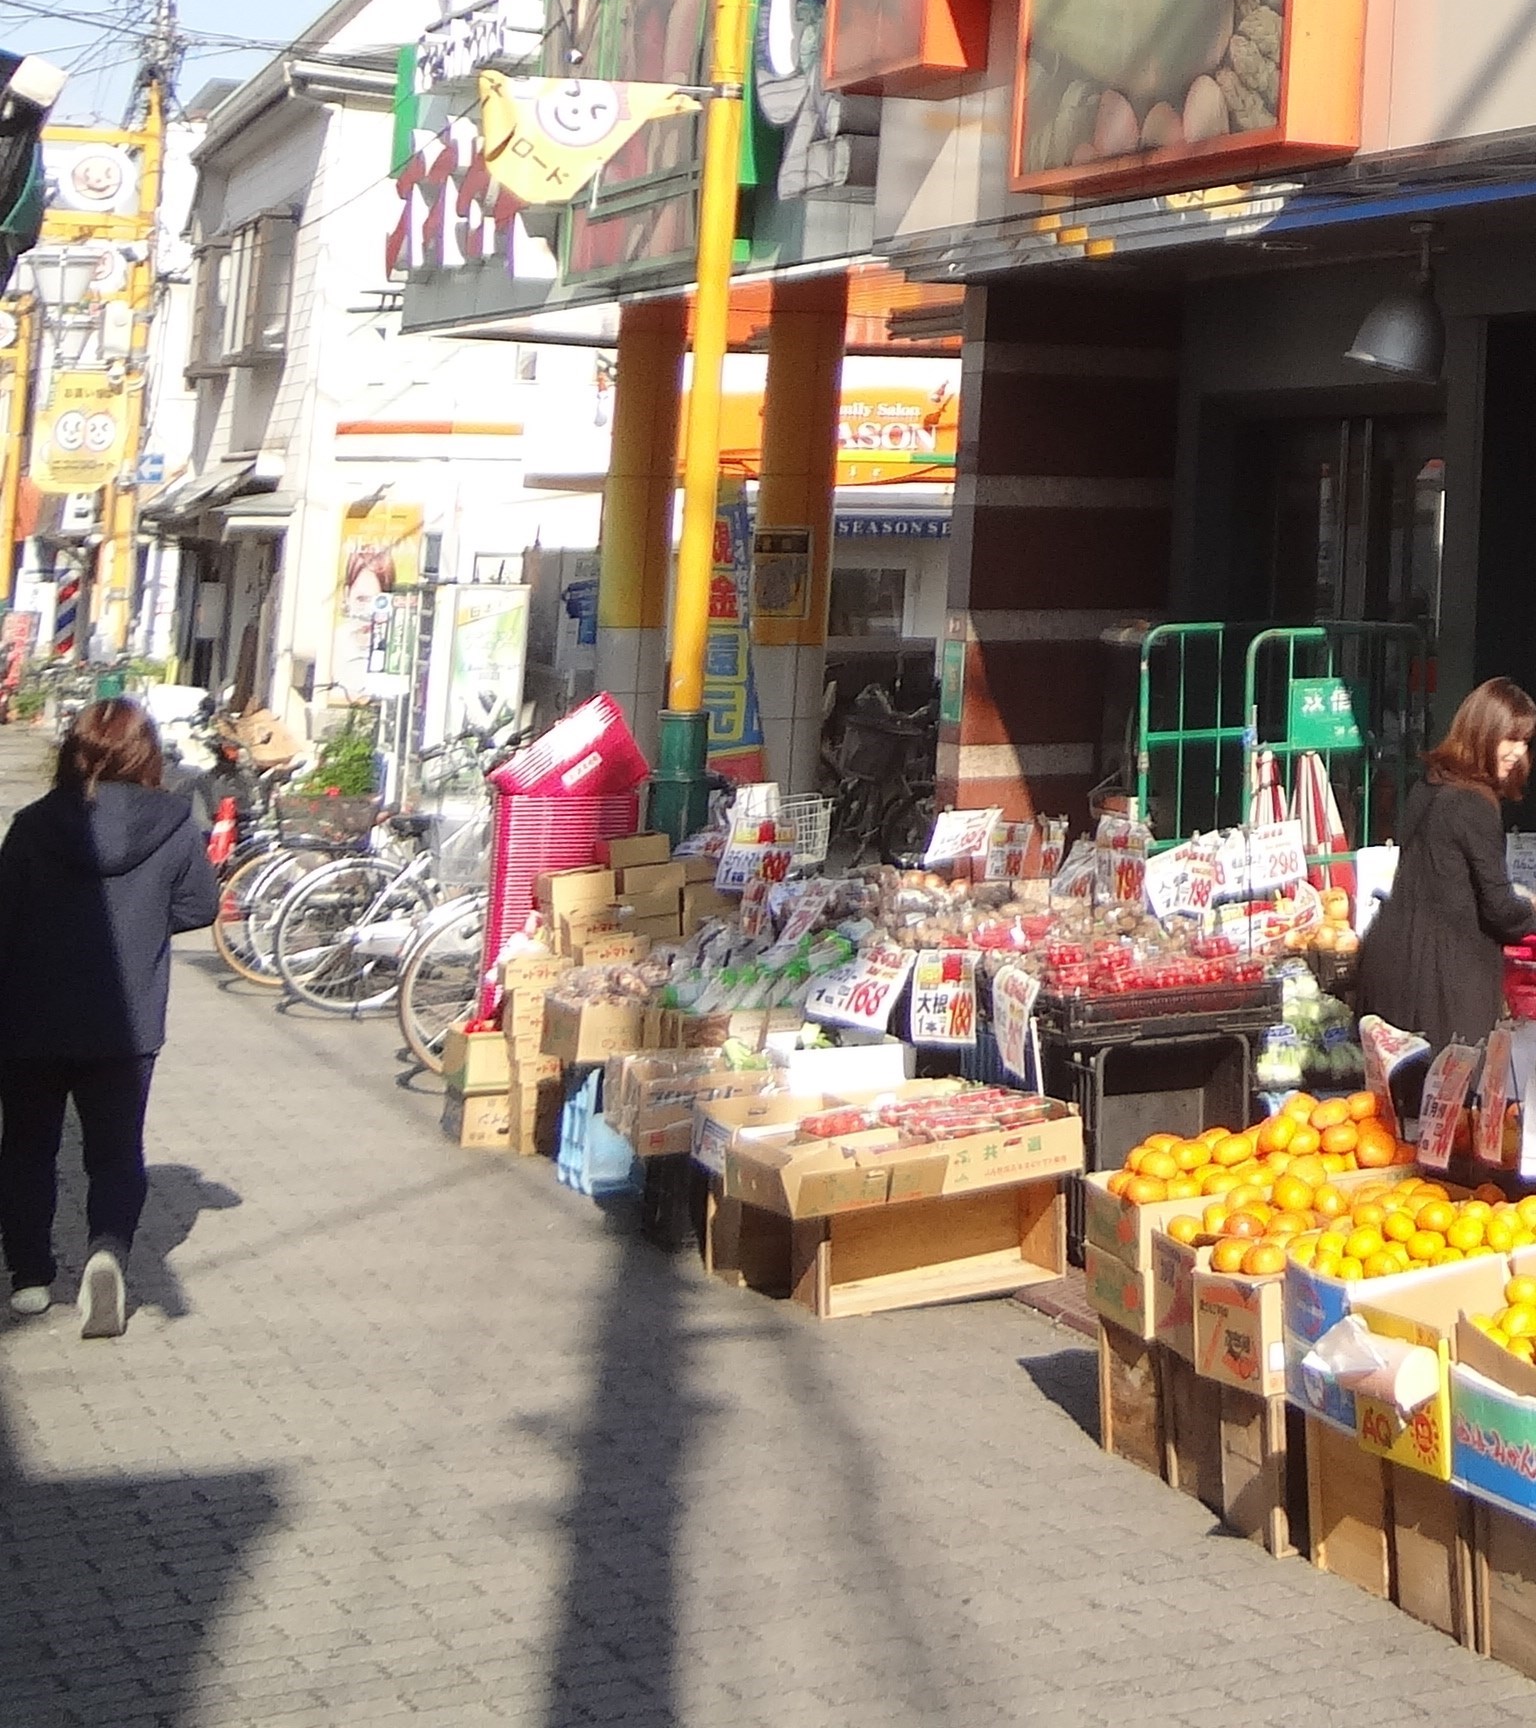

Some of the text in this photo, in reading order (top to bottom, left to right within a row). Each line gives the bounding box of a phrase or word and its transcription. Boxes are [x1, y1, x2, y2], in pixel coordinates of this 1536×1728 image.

[877, 402, 921, 418] Salon
[838, 422, 937, 453] ASON
[838, 520, 922, 534] SEASON
[1269, 850, 1299, 878] 298
[916, 993, 949, 1015] 大根
